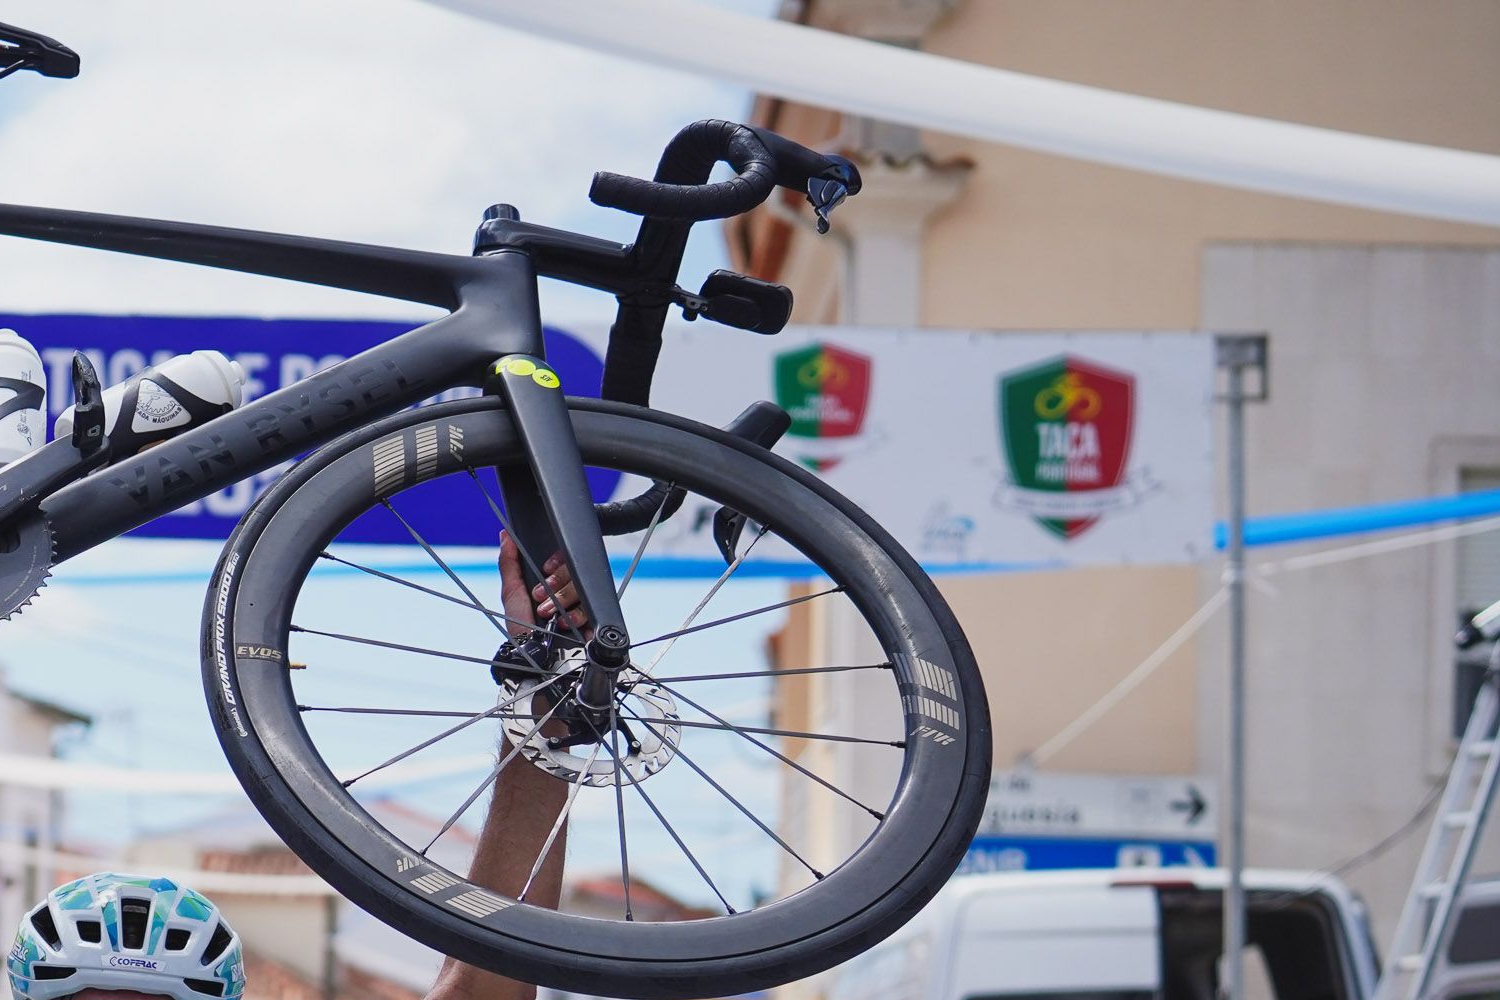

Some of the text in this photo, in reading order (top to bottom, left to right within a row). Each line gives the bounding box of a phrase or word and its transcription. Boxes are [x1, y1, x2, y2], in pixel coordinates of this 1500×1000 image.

[107, 433, 237, 502] VAN
[215, 616, 228, 655] PRIX
[217, 653, 237, 706] GRAND
[117, 957, 157, 970] COFERAC
